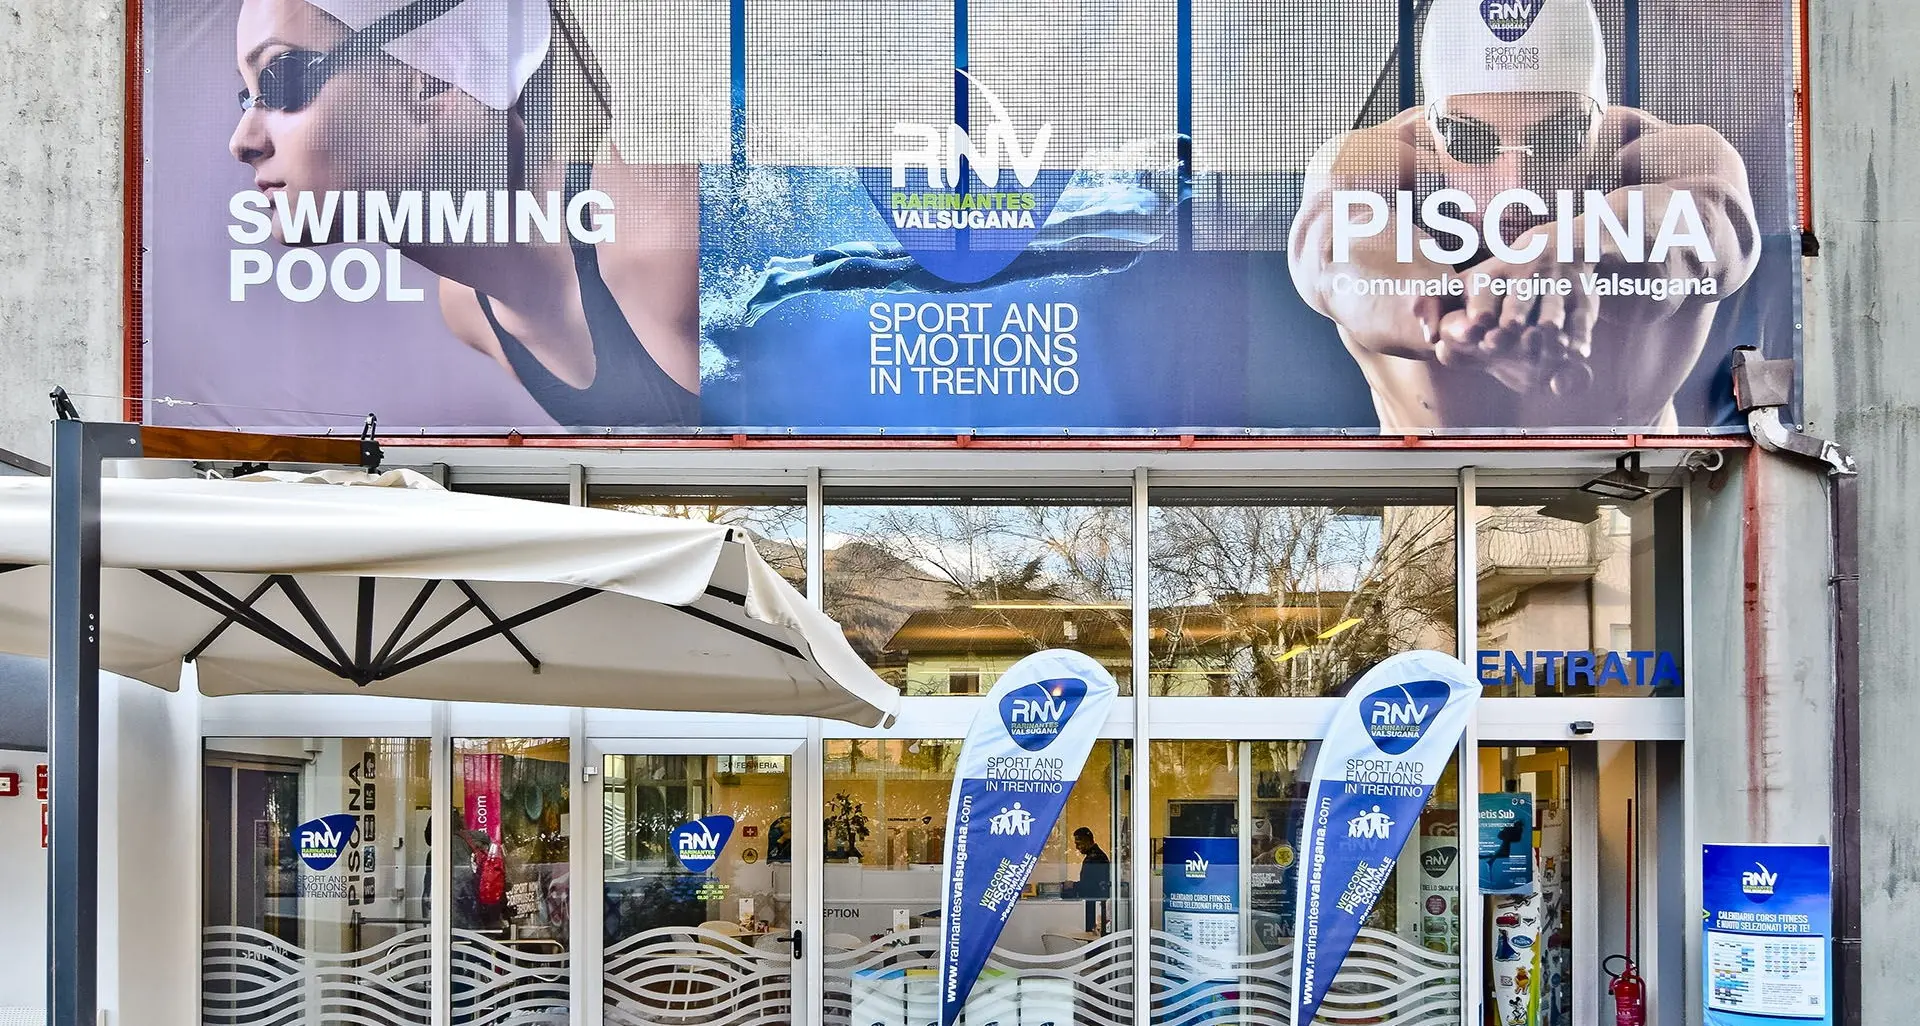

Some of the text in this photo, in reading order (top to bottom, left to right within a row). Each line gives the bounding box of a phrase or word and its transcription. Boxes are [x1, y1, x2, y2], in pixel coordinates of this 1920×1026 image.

[1489, 2, 1531, 19] RNV
[1485, 47, 1516, 56] SPORT
[1486, 55, 1539, 63] EMOTIONS
[892, 121, 1051, 188] RNV
[892, 193, 1036, 210] RARINANTES
[228, 190, 616, 245] SWIMMING
[892, 211, 1036, 229] VALSUGANA
[1332, 189, 1717, 266] PISCINA
[230, 248, 424, 302] POOL
[1332, 273, 1717, 302] Comunale Pergine Valsugana
[869, 303, 1079, 333] SPORT AND
[870, 334, 1078, 366] EMOTIONS
[870, 367, 1080, 395] IN TRENTINO
[1477, 650, 1680, 686] ENTRATA
[1012, 699, 1066, 722] RNV
[1372, 701, 1428, 724] RNV
[986, 757, 1064, 770] SPORT AND
[1346, 759, 1424, 772] SPORT AND
[986, 768, 1062, 781] EMOTIONS
[1346, 772, 1422, 785] EMOTIONS
[986, 781, 1062, 794] IN TRENTINO
[1344, 783, 1423, 797] IN TRENTINO
[1478, 810, 1514, 819] etis Sub
[301, 831, 342, 848] RNV
[680, 832, 720, 849] RNV
[1186, 860, 1208, 871] RNV
[1426, 856, 1449, 866] RNV
[328, 875, 347, 883] AND
[979, 857, 1010, 907] WELCOME
[1004, 852, 1032, 901] COMUNALE
[1336, 860, 1368, 910] WELCOME
[1362, 856, 1392, 904] COMUNALE
[1742, 872, 1778, 886] RNV
[987, 864, 1019, 912] PISCINA
[1344, 868, 1378, 915] PISCINA
[947, 796, 972, 1002] www.rarinantesvalsugana.com
[1303, 797, 1332, 1005] www.rarinantesvalsugana.com
[823, 909, 859, 918] EPTION
[1718, 910, 1808, 924] CALENDARIO CORSI FITNESS
[1740, 922, 1782, 932] SELEZIONATI
[1784, 924, 1798, 932] PER
[1800, 924, 1810, 932] TE!
